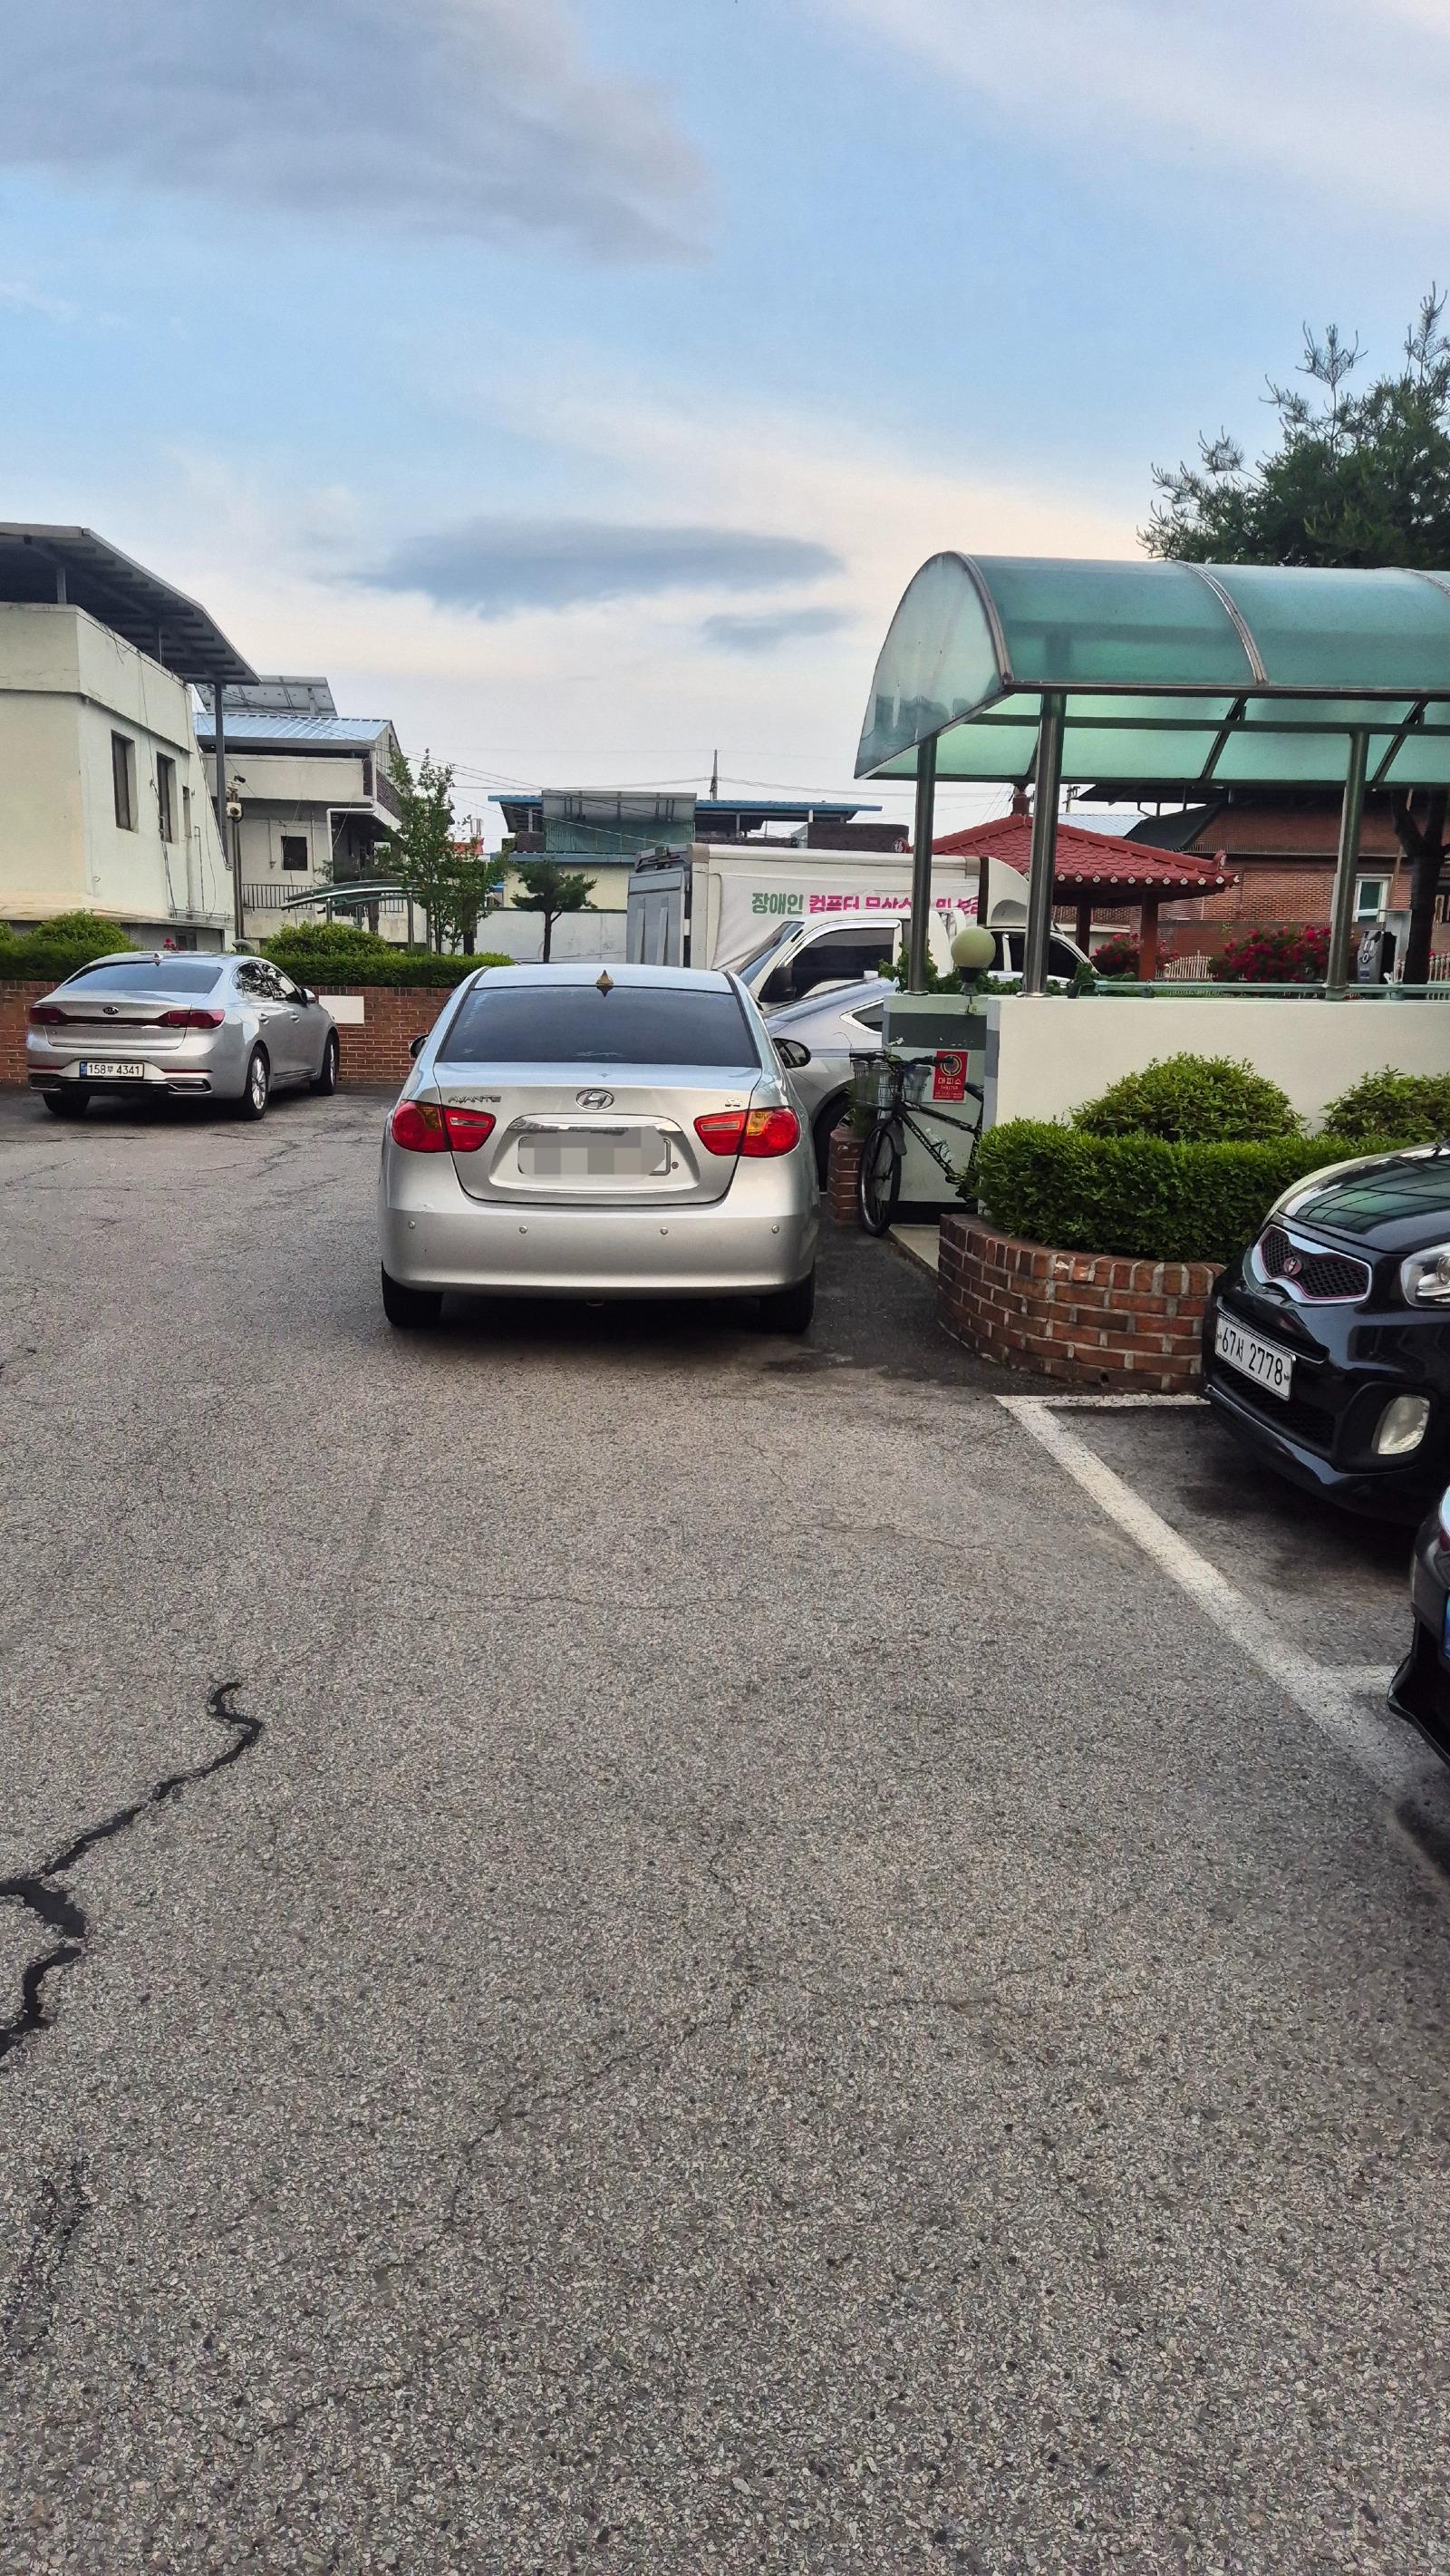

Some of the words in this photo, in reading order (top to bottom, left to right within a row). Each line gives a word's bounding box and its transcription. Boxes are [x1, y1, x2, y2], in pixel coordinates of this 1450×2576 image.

[752, 893, 804, 915] 장애인
[88, 1064, 114, 1074] 158부
[116, 1065, 140, 1075] 4341
[938, 1077, 962, 1085] 대피소
[448, 1094, 502, 1104] AVANTE
[1222, 1327, 1244, 1362] 67서
[1248, 1342, 1283, 1386] 2778
